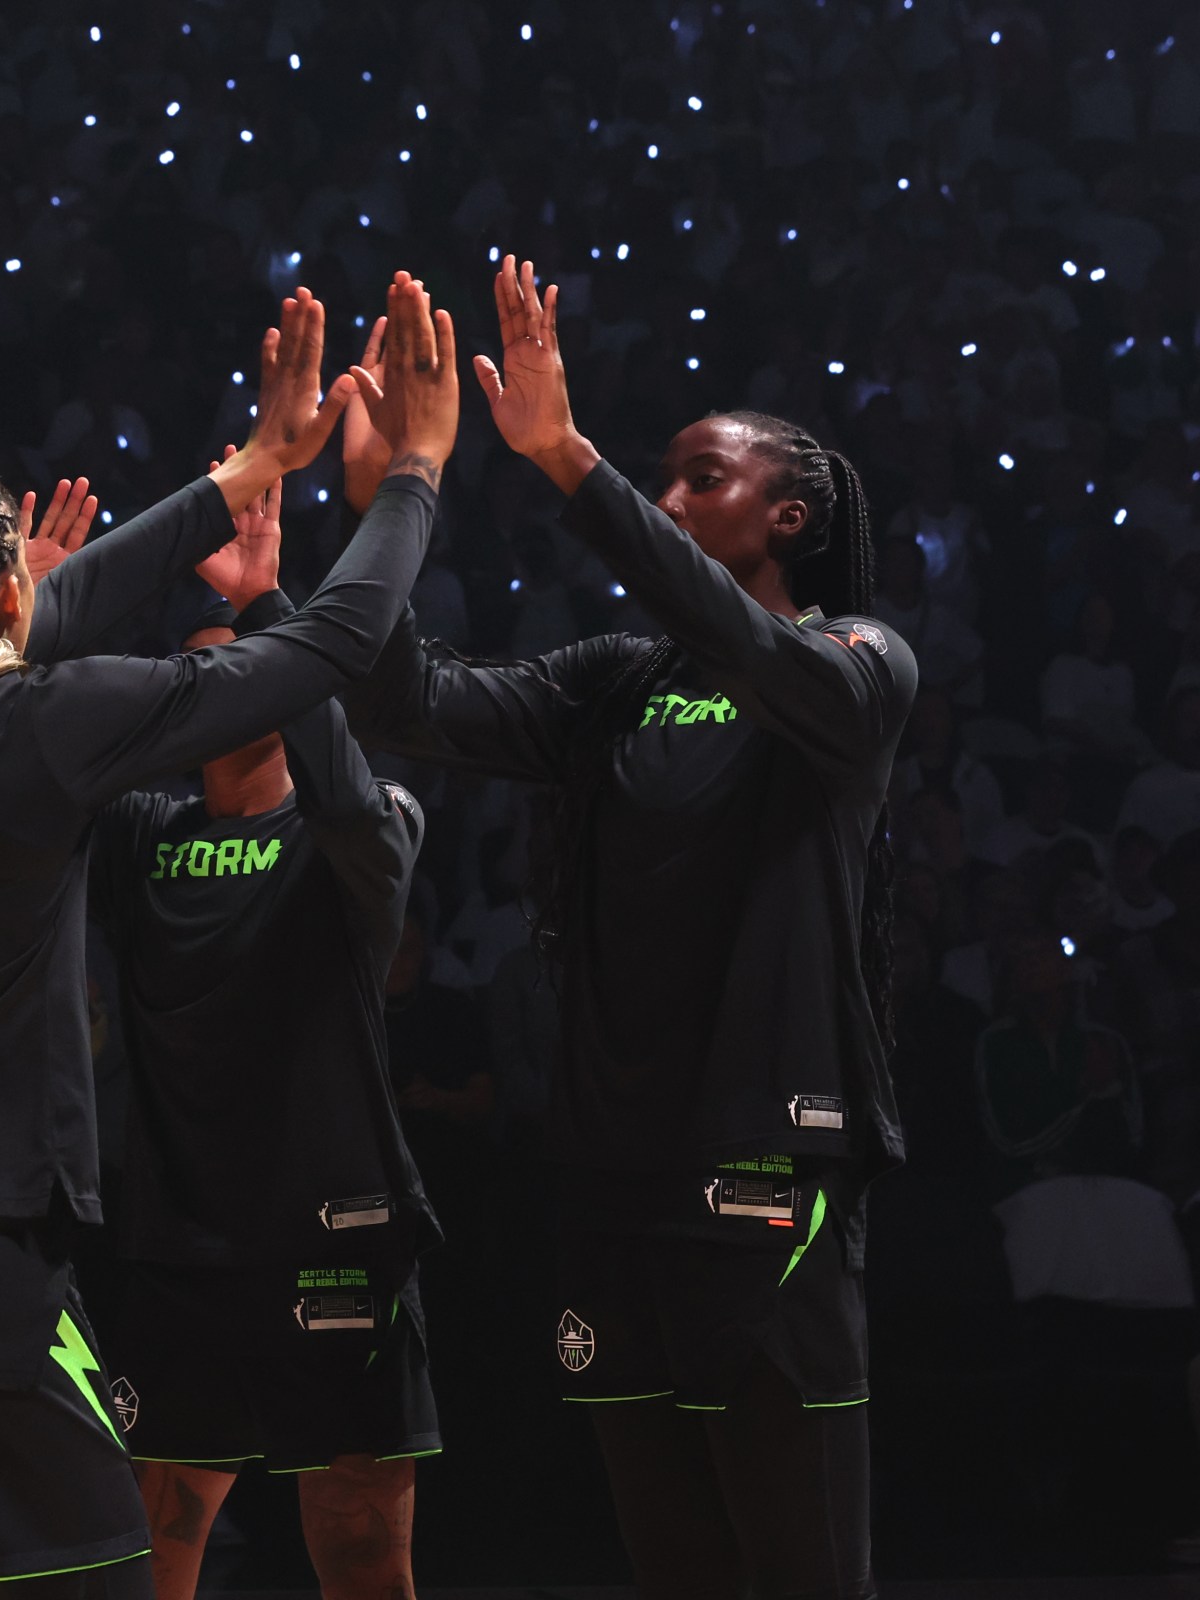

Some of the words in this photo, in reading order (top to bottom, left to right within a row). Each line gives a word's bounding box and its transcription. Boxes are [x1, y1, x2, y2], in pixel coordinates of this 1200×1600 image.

[637, 692, 738, 731] STOR
[149, 839, 283, 879] STORM
[736, 1161, 760, 1171] REBEL
[761, 1163, 793, 1174] EDITION
[299, 1269, 336, 1278] SEATTLE
[339, 1269, 366, 1277] STORM
